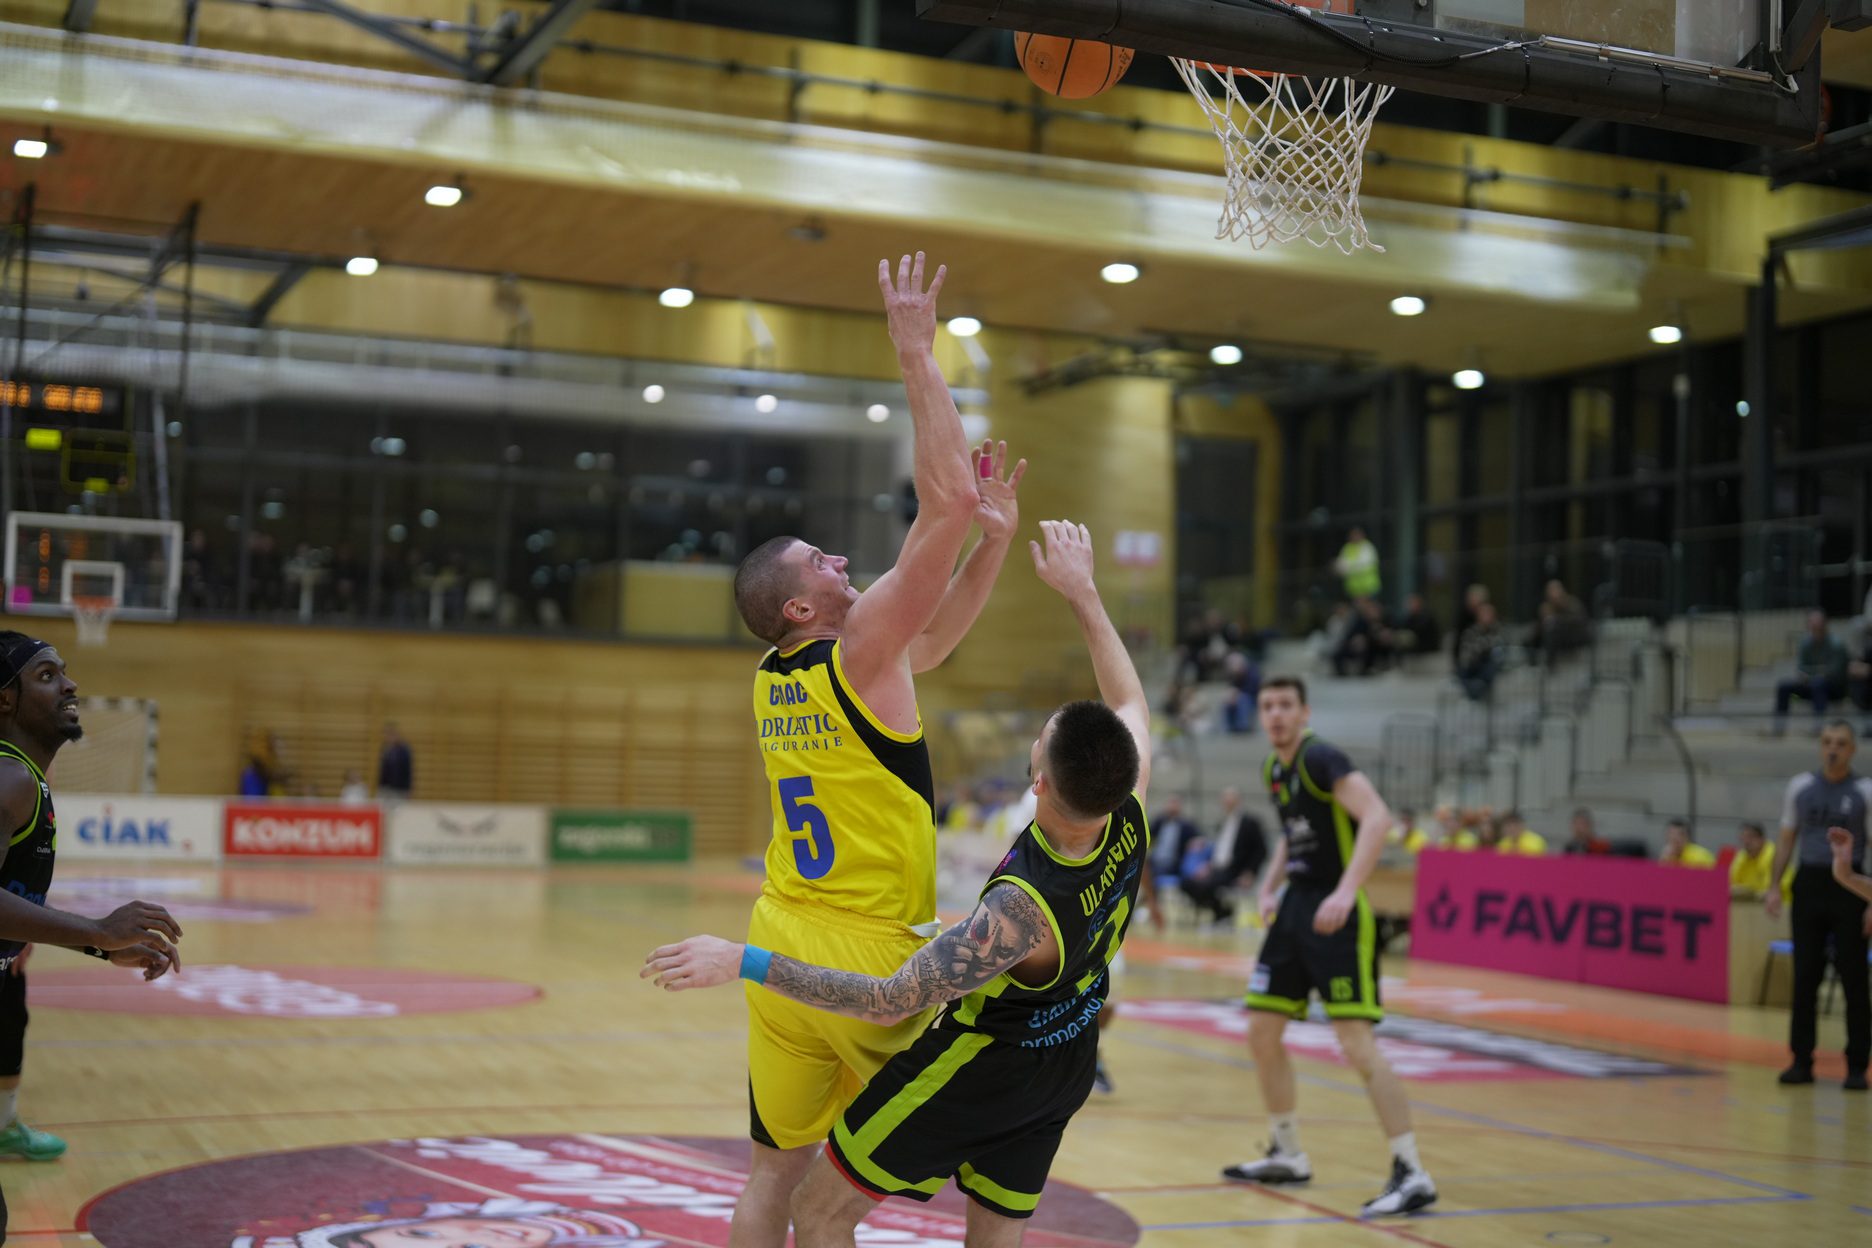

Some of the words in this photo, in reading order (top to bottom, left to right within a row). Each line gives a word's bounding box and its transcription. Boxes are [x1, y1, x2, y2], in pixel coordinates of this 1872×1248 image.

[757, 713, 838, 738] DRIATIC
[761, 736, 843, 752] IGURANJE
[231, 814, 373, 848] KONZUM
[778, 775, 836, 880] 5
[1474, 888, 1713, 961] FAVBET
